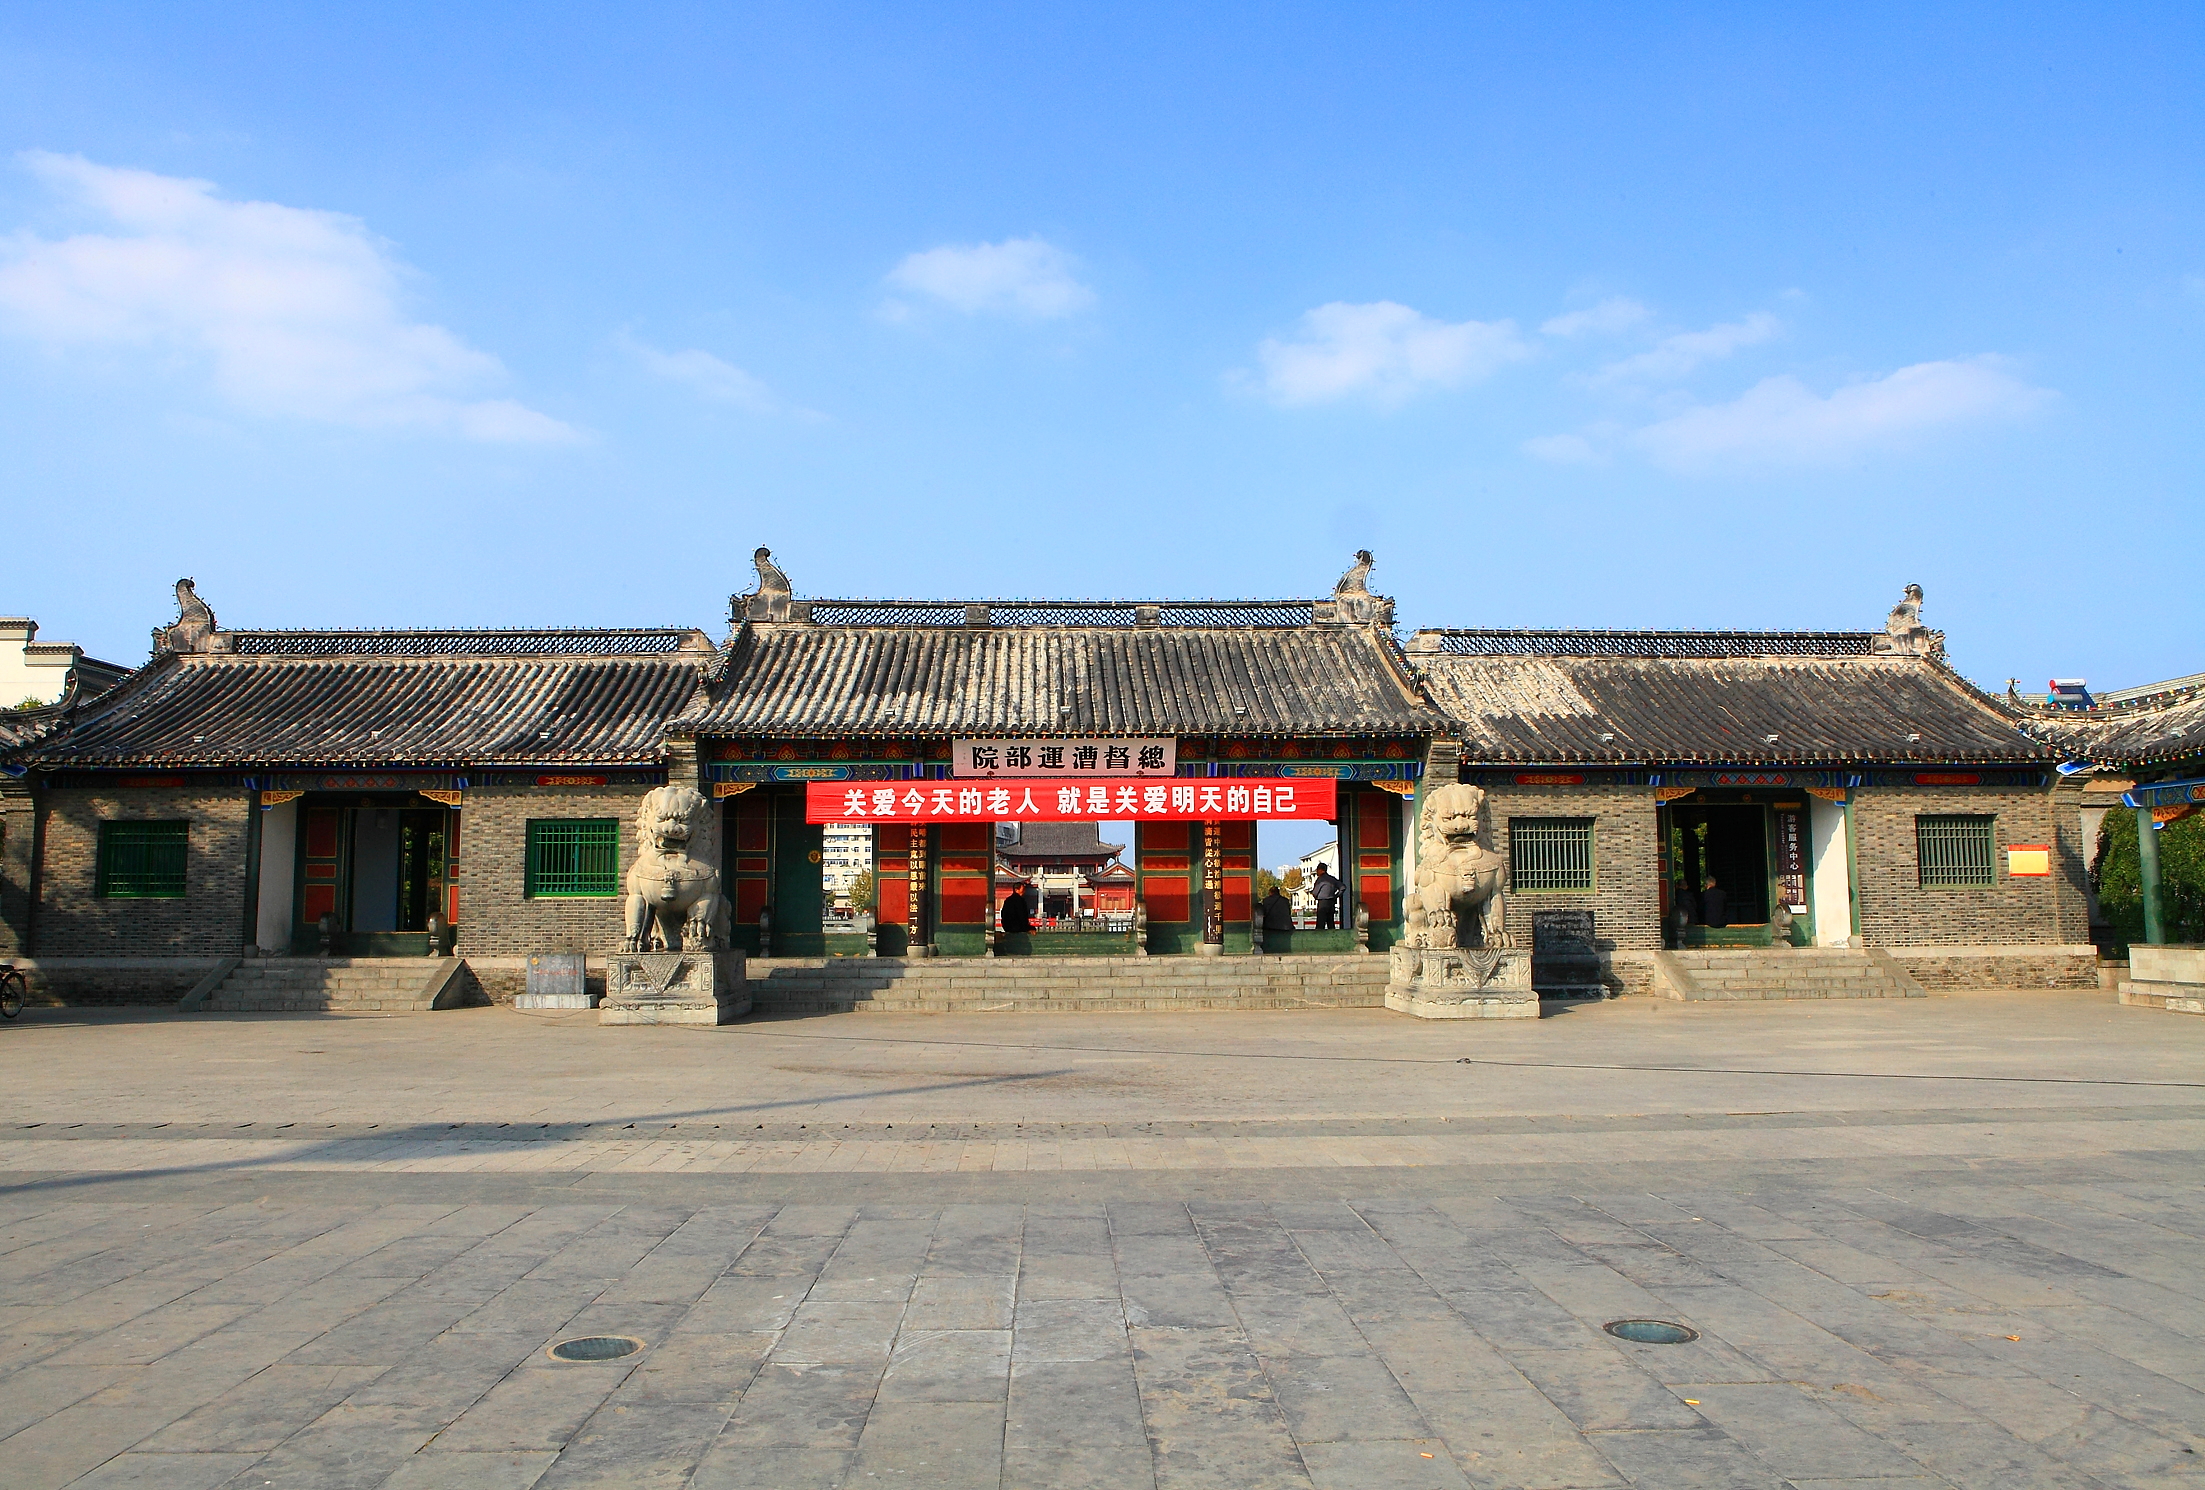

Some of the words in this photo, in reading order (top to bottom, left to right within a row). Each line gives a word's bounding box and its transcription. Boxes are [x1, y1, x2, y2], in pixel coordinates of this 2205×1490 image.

[843, 787, 1040, 817] 关爱今天的老人
[1056, 785, 1297, 815] 就是关爱明天的自己
[1787, 814, 1799, 871] 游客服务中心
